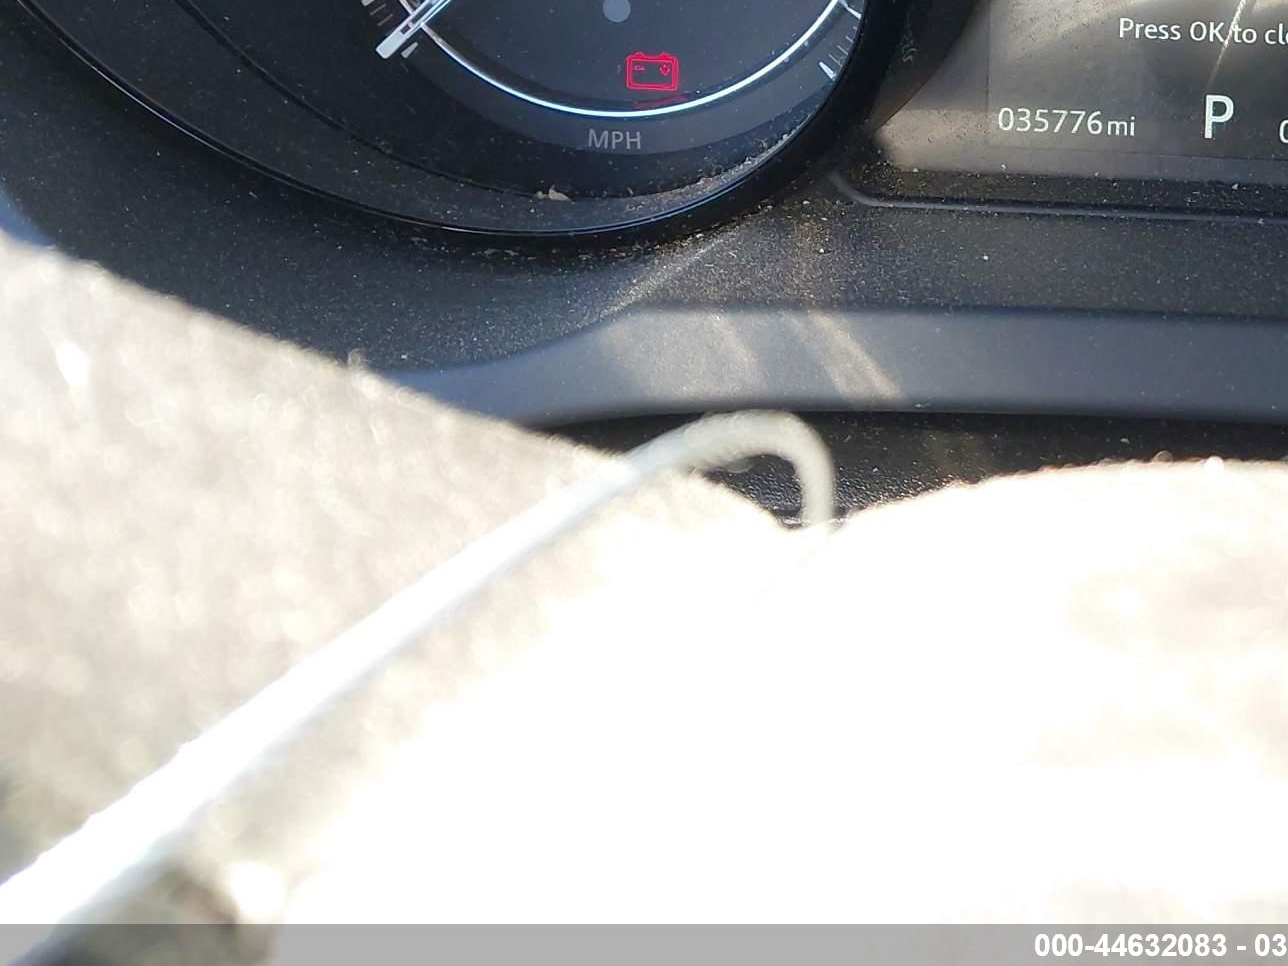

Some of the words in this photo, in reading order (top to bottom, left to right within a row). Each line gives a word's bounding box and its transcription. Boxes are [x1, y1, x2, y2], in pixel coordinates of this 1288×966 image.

[1118, 17, 1181, 42] Press
[1189, 20, 1225, 42] OK
[1231, 23, 1257, 45] to
[1203, 94, 1235, 139] P
[588, 129, 642, 152] MPH
